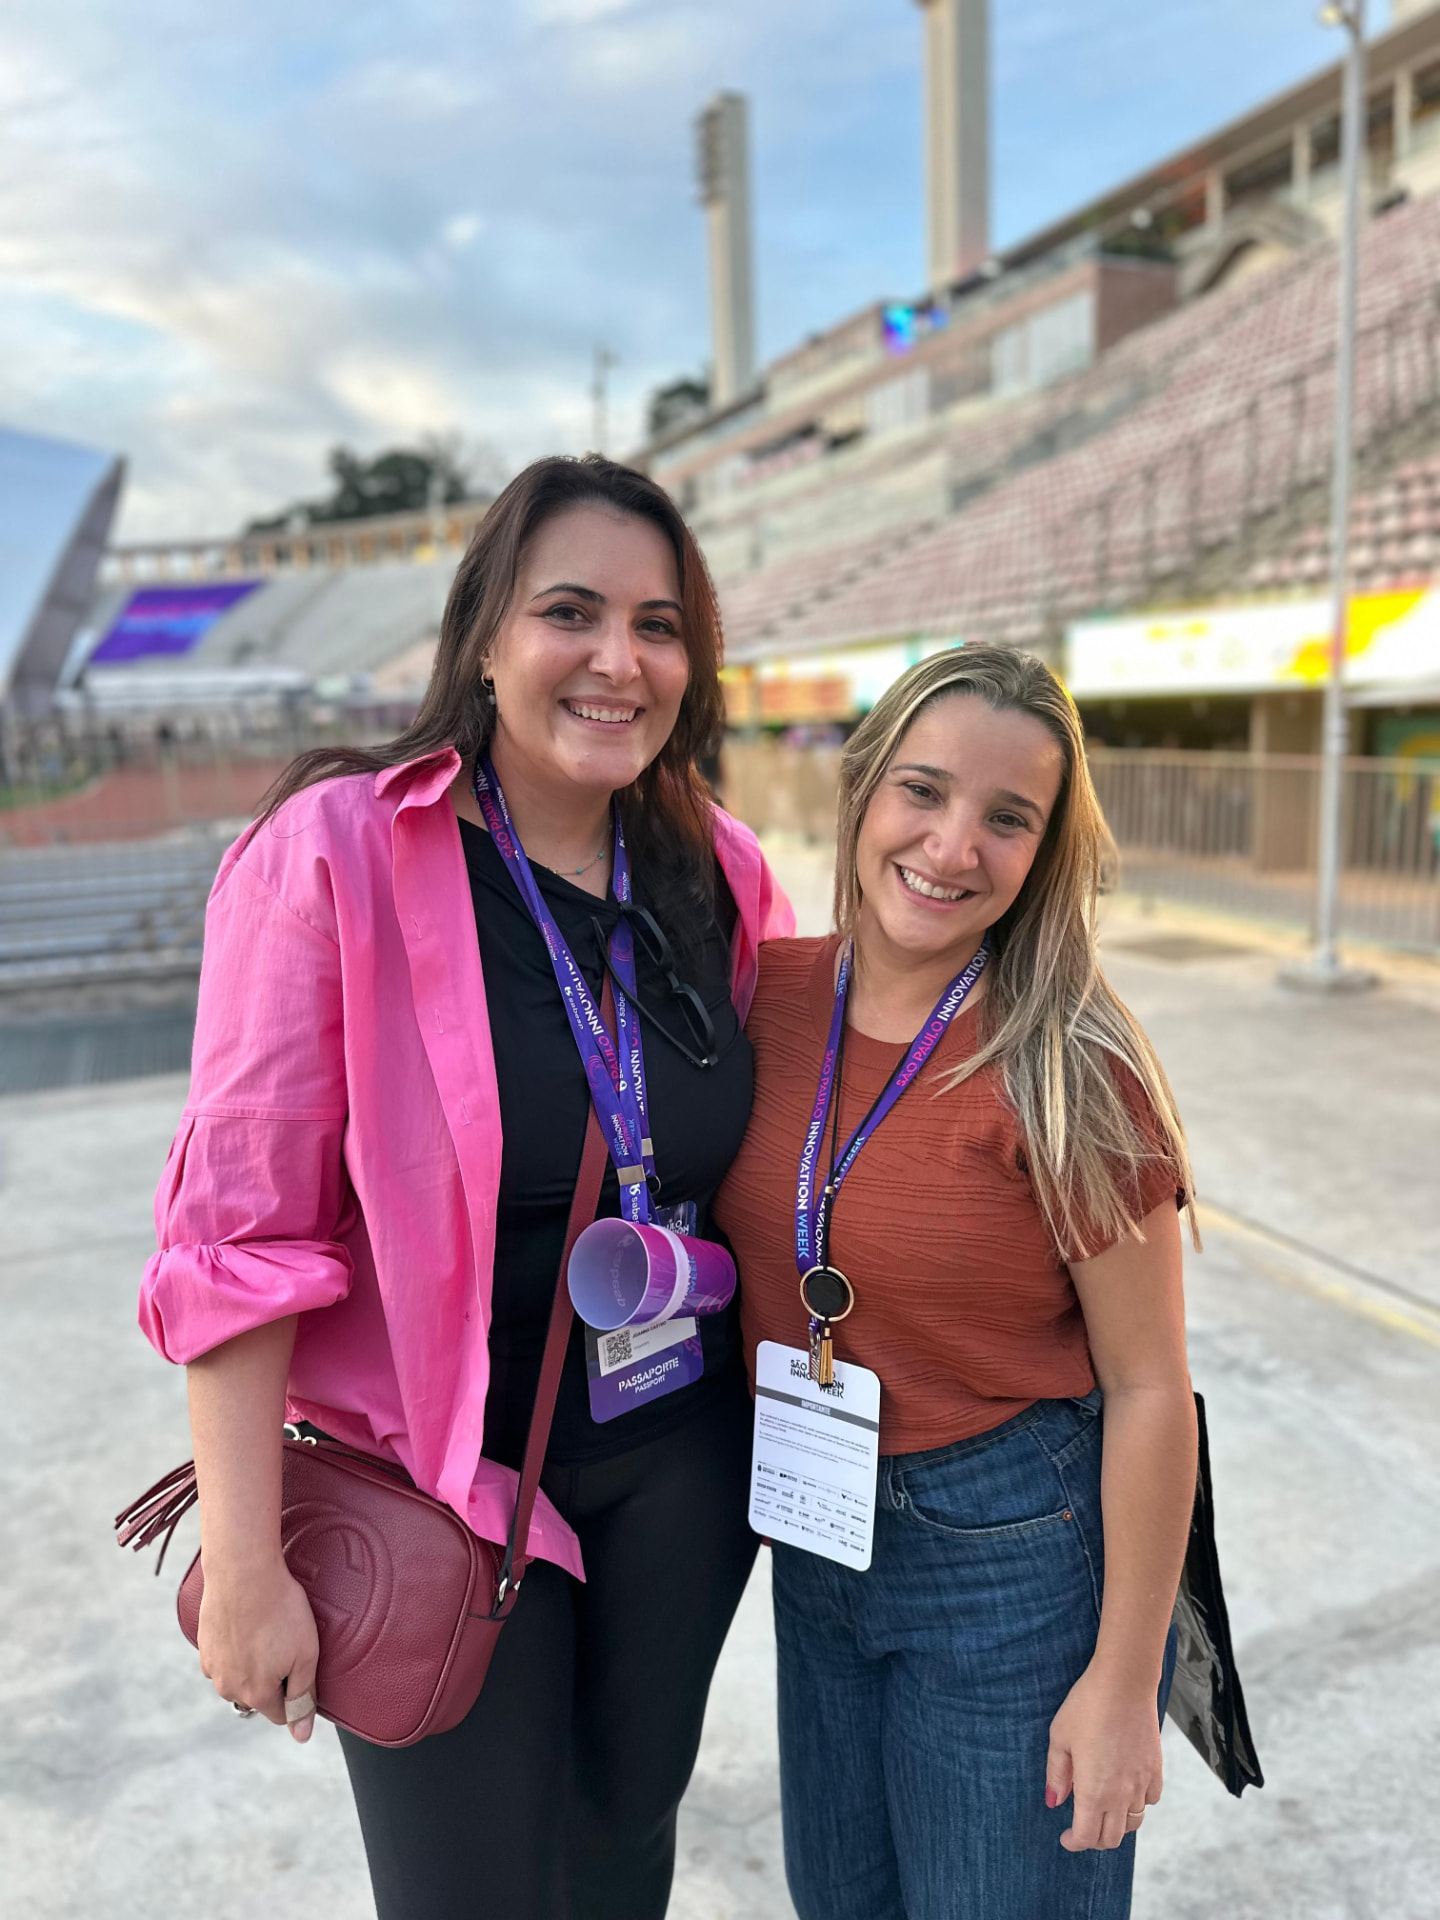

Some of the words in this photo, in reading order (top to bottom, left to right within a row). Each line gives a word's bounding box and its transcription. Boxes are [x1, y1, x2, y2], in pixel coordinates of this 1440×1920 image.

[480, 791, 504, 831] PAULO
[896, 1061, 919, 1087] SÃO
[912, 1020, 944, 1063] PAULO
[937, 948, 989, 1021] INNOVATION
[821, 1049, 834, 1076] SÃO
[813, 1077, 829, 1119] PAULO
[610, 1114, 629, 1156] INNOVATION
[798, 1121, 820, 1210] INNOVATION
[798, 1213, 810, 1258] WEEK
[618, 1357, 679, 1392] PASSAPORTE
[634, 1375, 666, 1394] PASSPORT
[790, 1359, 807, 1371] SÃO
[819, 1386, 845, 1399] WEEK
